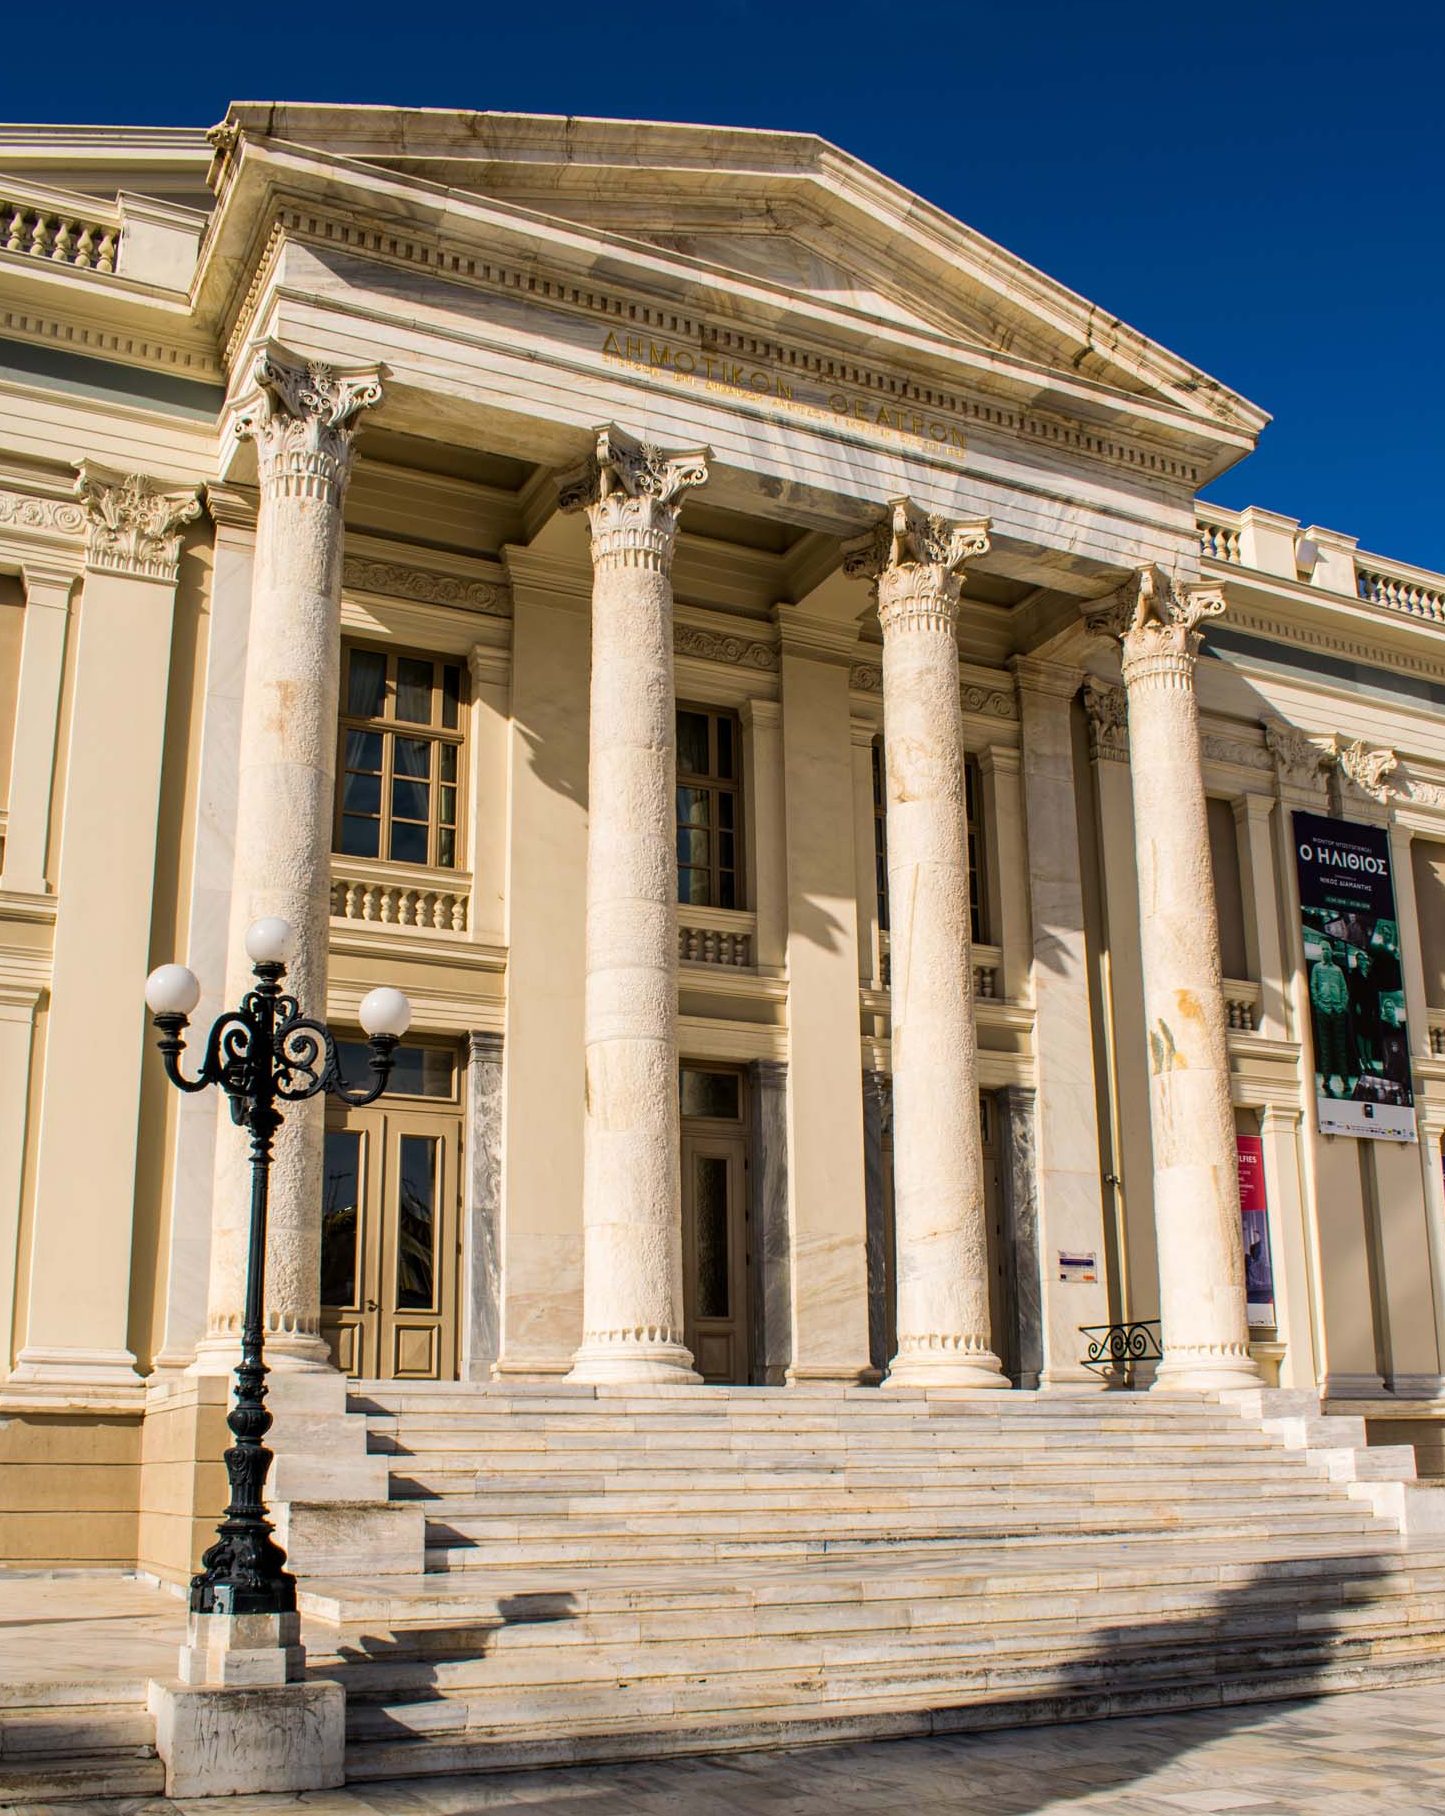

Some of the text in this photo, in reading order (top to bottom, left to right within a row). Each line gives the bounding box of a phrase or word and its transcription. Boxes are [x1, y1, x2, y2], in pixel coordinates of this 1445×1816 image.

[602, 330, 793, 399] ΔΗΜΟΤΙΚΟΝ
[828, 393, 968, 449] ΘΕΑΤΡΟΝ
[1299, 844, 1388, 876] Ο ΗΛΙΘΙΟΣ
